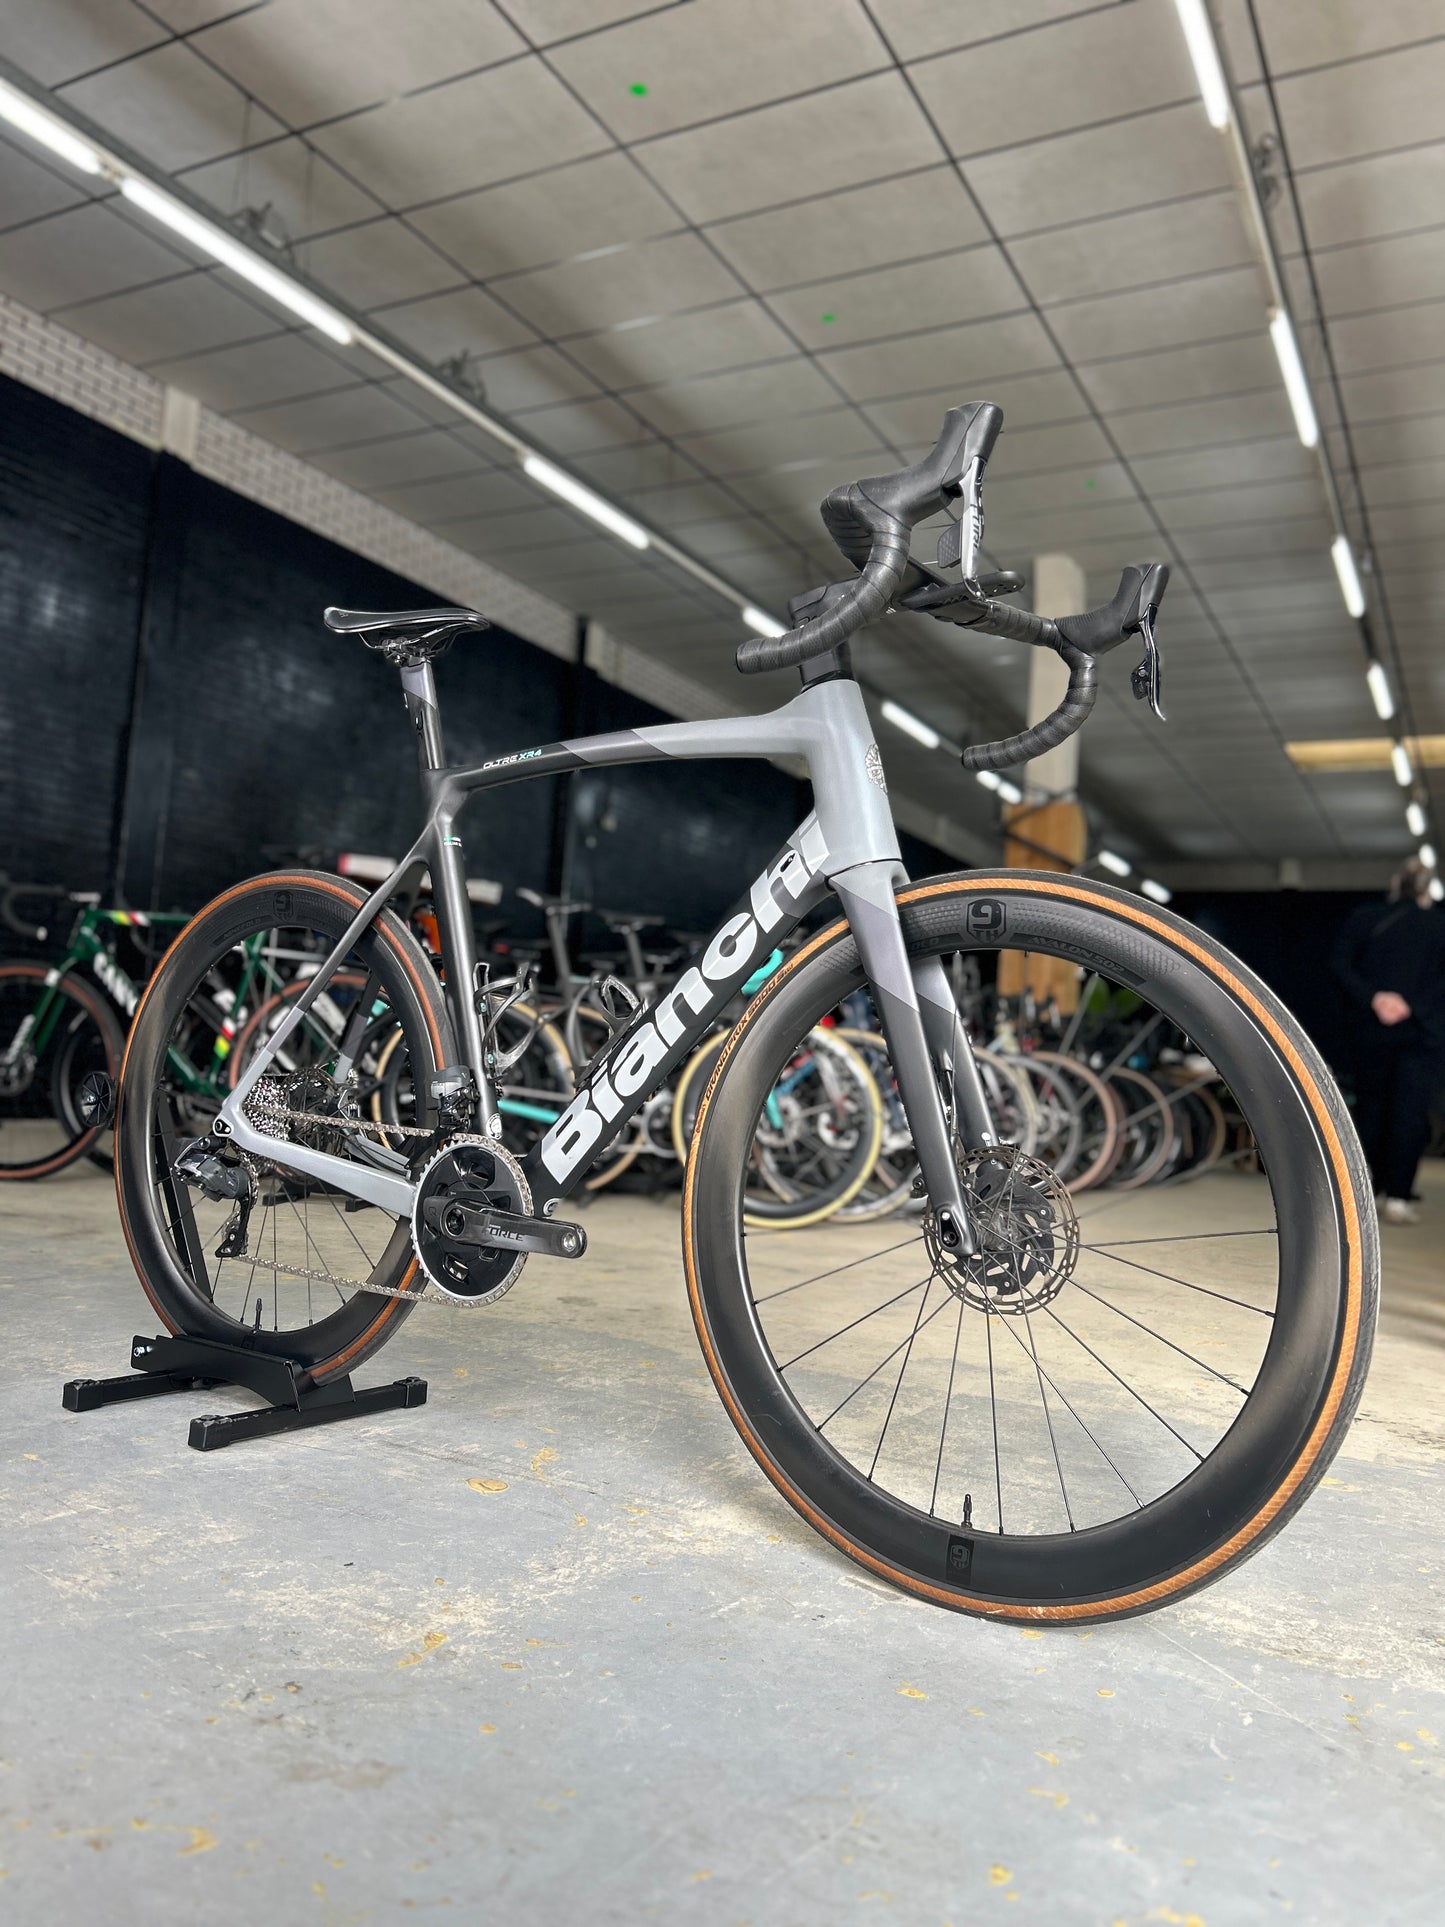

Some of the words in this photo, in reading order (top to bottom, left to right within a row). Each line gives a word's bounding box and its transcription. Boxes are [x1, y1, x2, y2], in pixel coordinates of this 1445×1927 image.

[483, 755, 518, 769] OLTRE
[518, 749, 541, 760] XR4
[971, 898, 1002, 930] 9
[1028, 936, 1093, 958] AVALON
[541, 811, 830, 1184] Bianchi
[705, 1048, 729, 1101] GRAND
[727, 1015, 748, 1050] PRIX
[747, 979, 776, 1018] 5000
